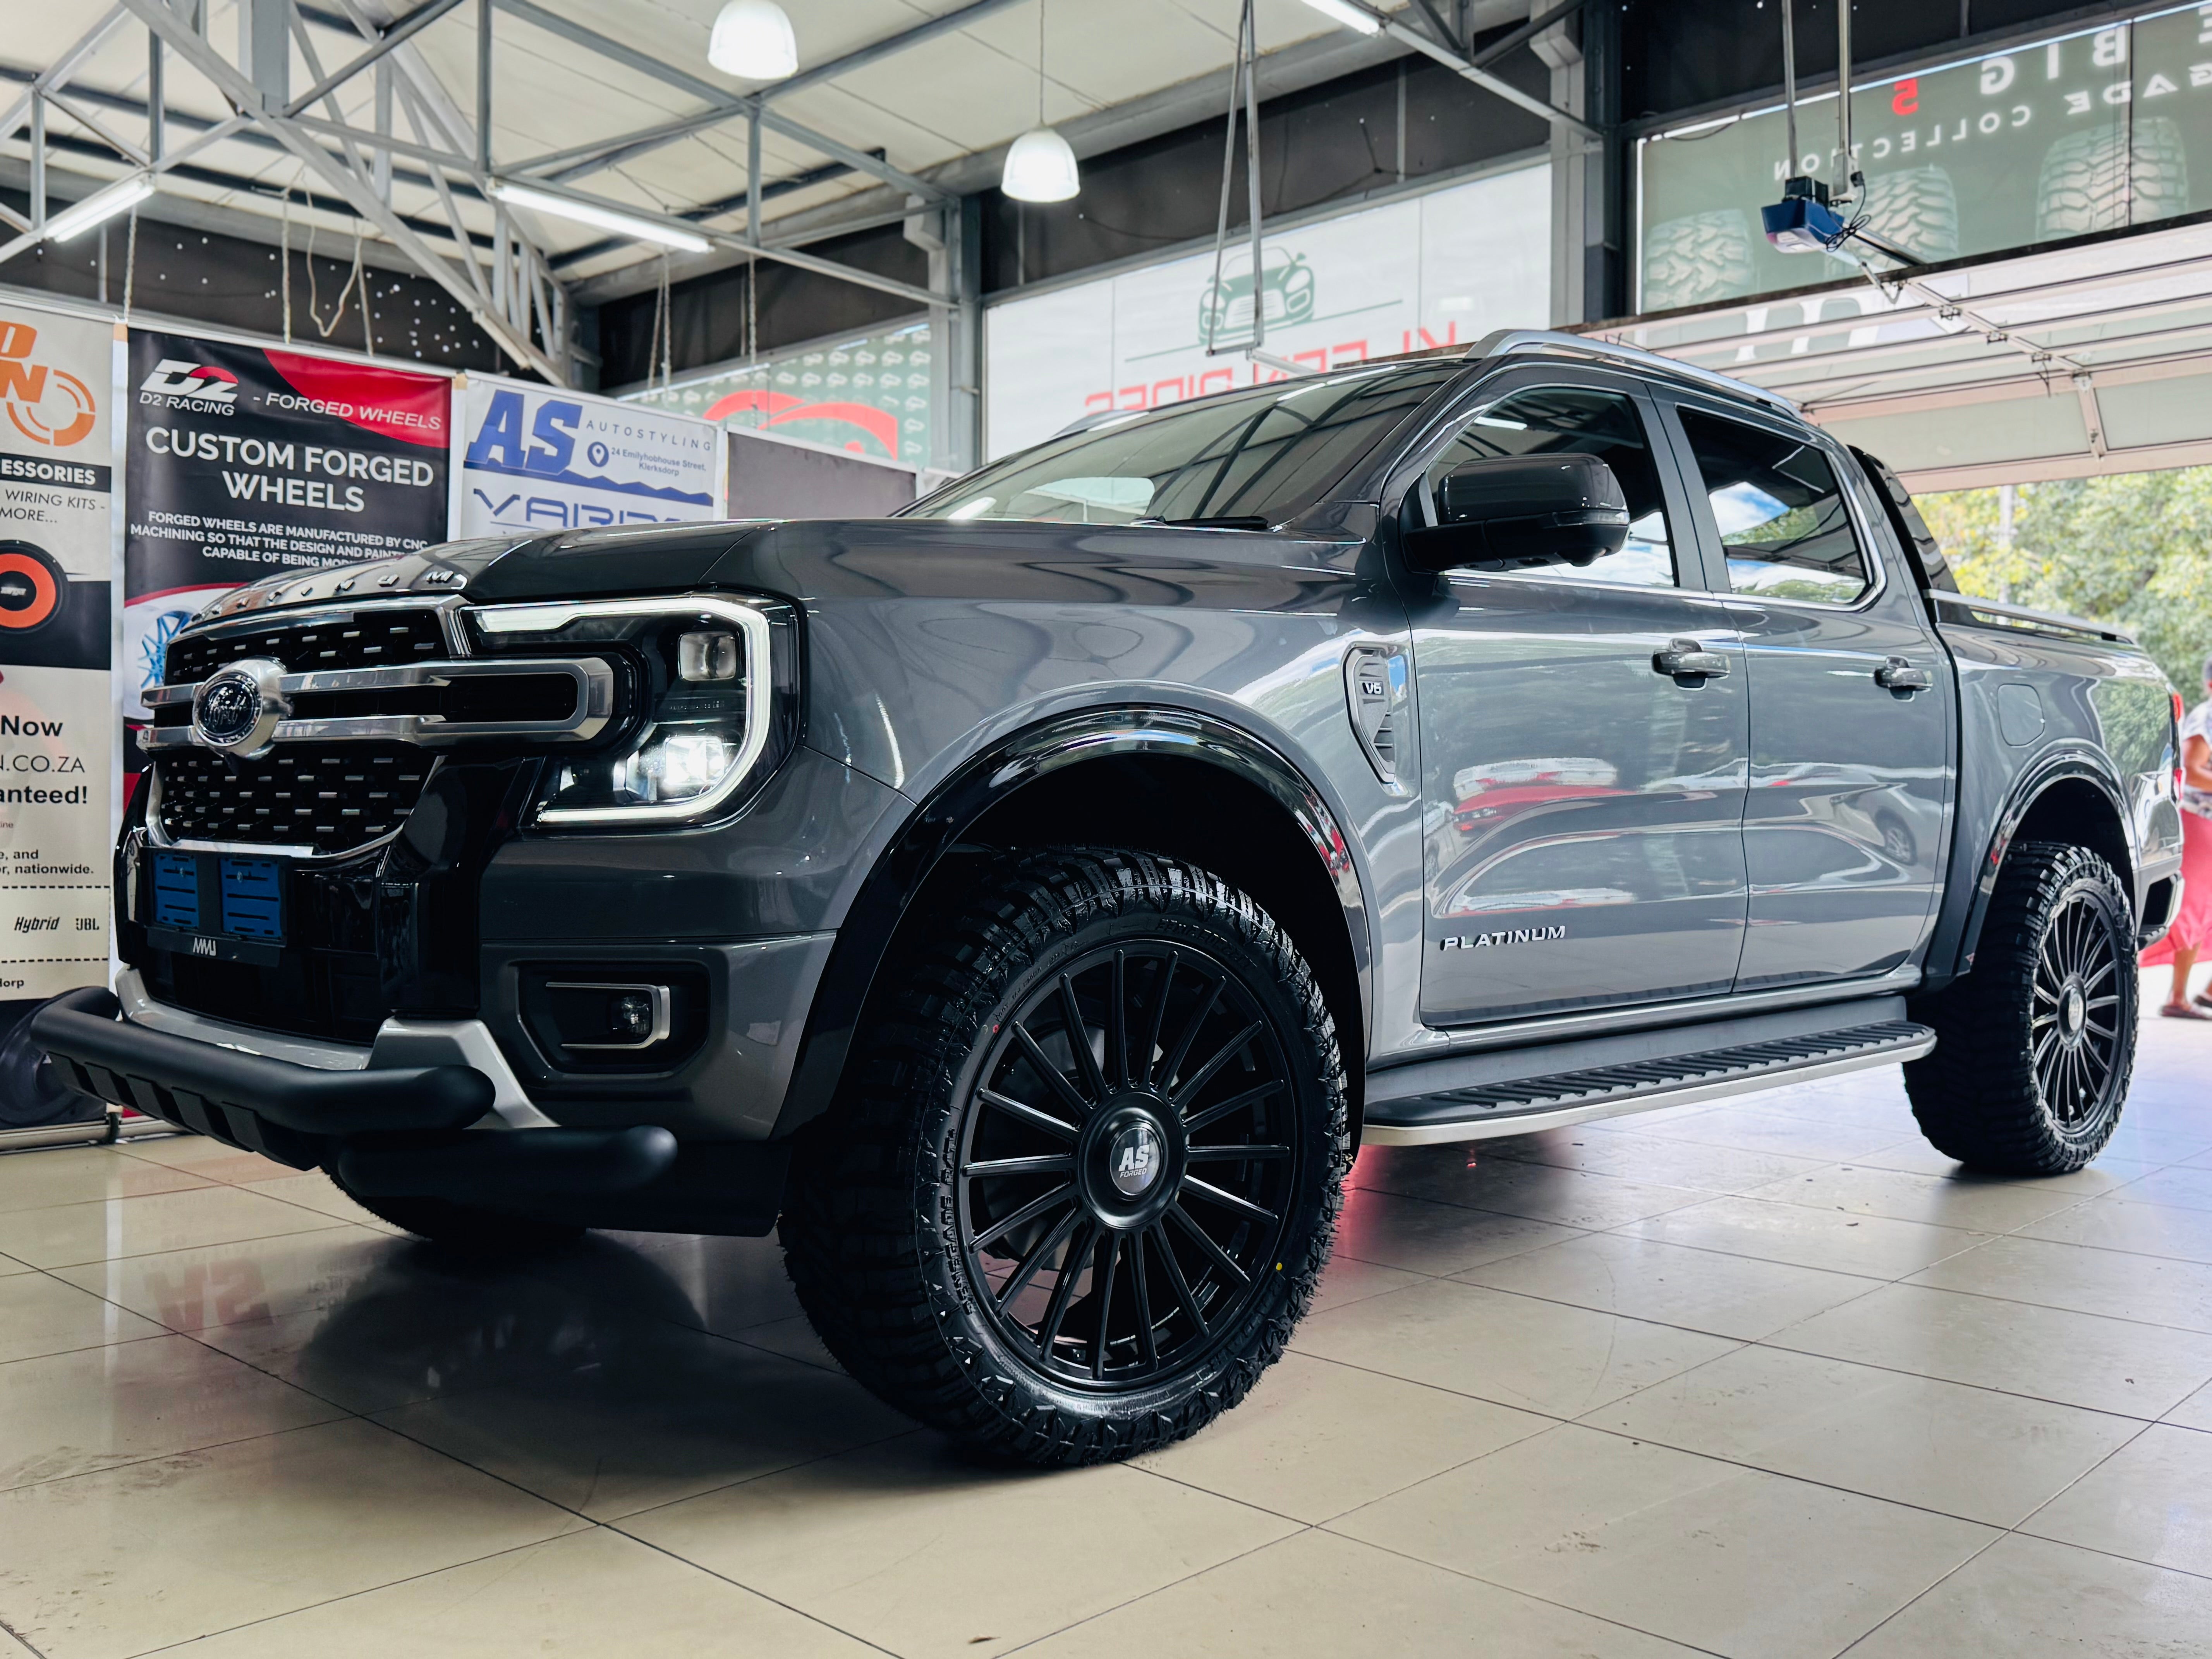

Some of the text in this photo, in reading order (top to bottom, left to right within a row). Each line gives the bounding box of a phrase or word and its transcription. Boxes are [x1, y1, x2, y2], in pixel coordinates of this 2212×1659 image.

[139, 392, 235, 416] D2 RACING
[265, 392, 353, 417] FORGED
[359, 406, 441, 430] WHEELS
[465, 390, 583, 475] AS
[586, 420, 711, 451] AUTOSTYLING
[146, 426, 434, 487] CUSTOM FORGED
[611, 447, 620, 455] 24
[0, 459, 96, 485] ESSORIES
[639, 463, 679, 477] Klerksdorp
[5, 489, 62, 507] WIRING
[67, 496, 96, 510] KITS
[222, 471, 364, 512] WHEELS
[131, 524, 205, 542] MACHINING
[208, 532, 225, 544] SO
[228, 534, 261, 547] THAT
[262, 537, 288, 550] THE
[290, 540, 335, 554] DESIGN
[337, 547, 363, 558] AND
[149, 511, 428, 550] FORGED WHEELS ARE MANUFACTURED BY CNC
[203, 546, 260, 561] CAPABLE
[262, 552, 280, 563] OF
[282, 553, 319, 567] BEING
[1364, 682, 1382, 694] V6
[1, 715, 63, 737] Now
[13, 849, 38, 859] and
[15, 863, 94, 874] nationwide.
[14, 916, 100, 933] Hybrid JBL
[1441, 925, 1565, 951] PLATINUM
[1118, 1144, 1149, 1171] AS
[1120, 1168, 1147, 1178] FORGED
